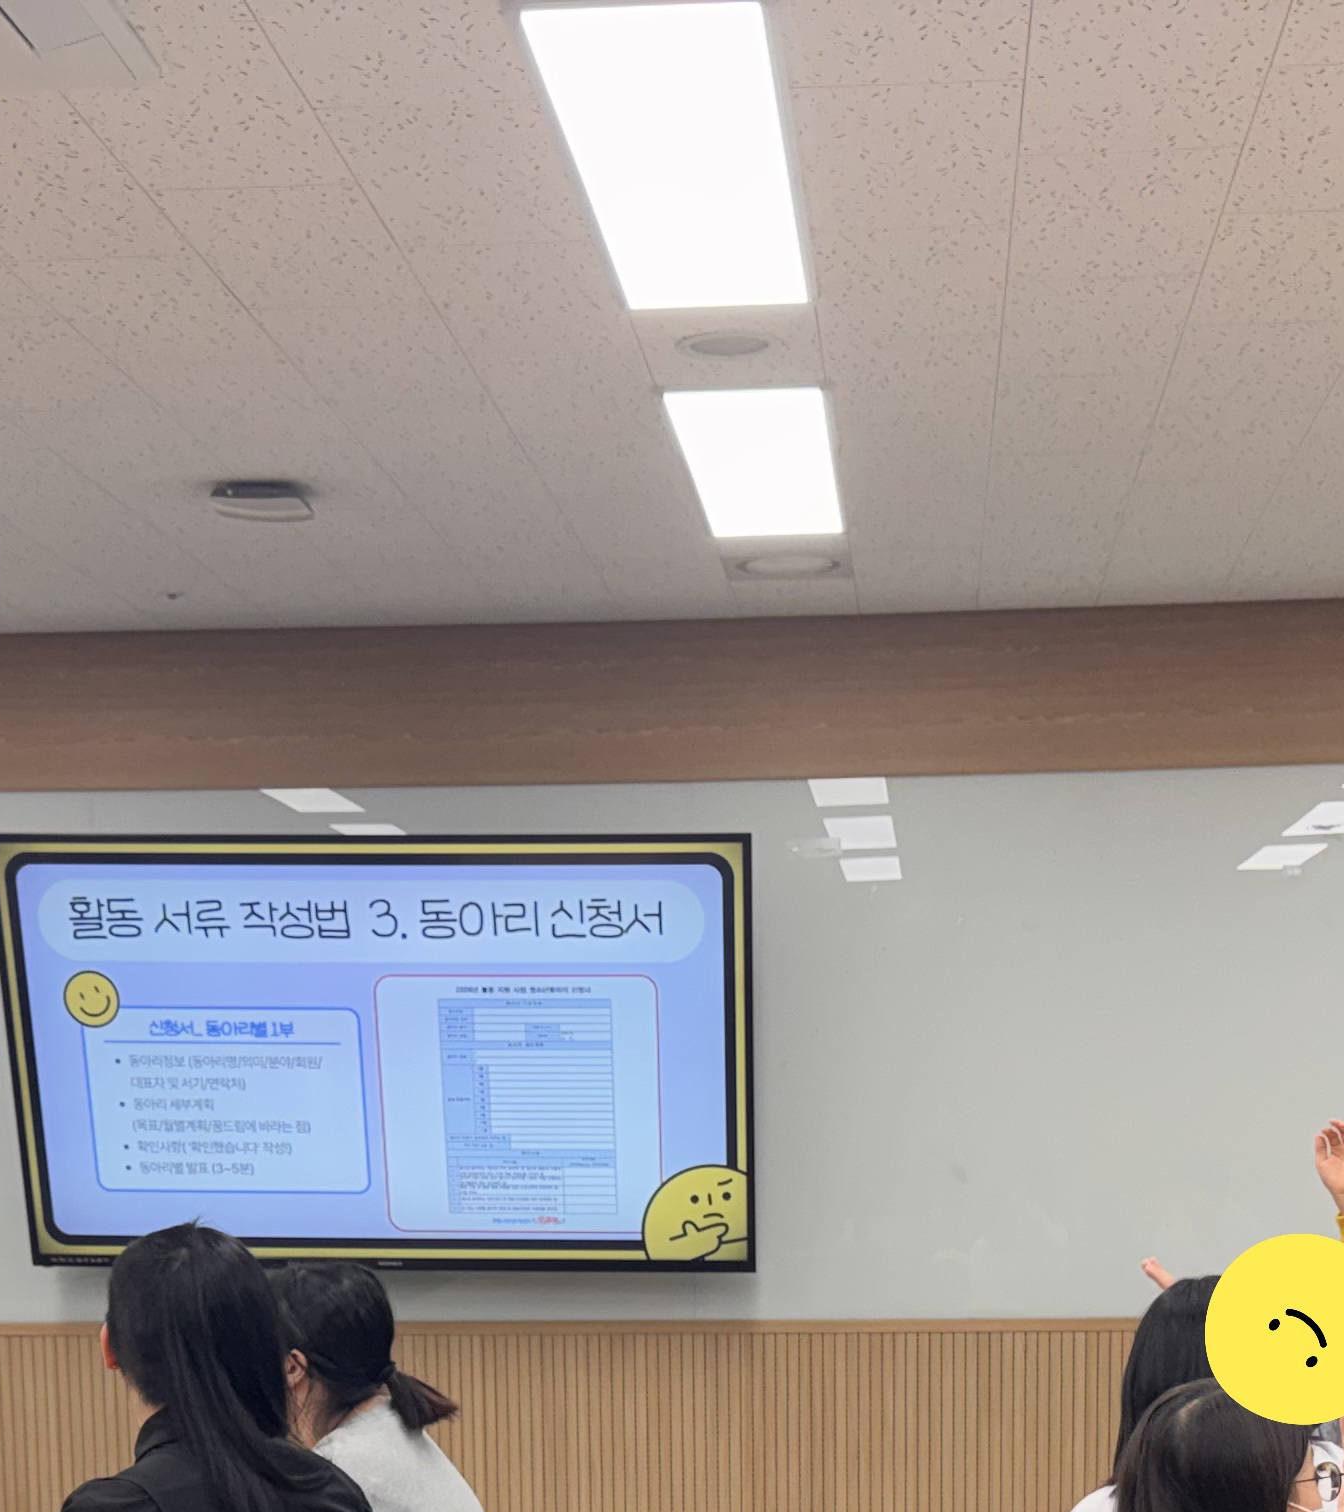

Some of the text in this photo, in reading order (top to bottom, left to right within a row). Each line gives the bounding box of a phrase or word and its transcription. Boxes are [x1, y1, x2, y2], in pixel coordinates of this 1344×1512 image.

[69, 896, 664, 940] 활동 서류 작성법 3. 동아리 신청서
[206, 1020, 268, 1038] 동아리별
[270, 1021, 295, 1038] 1부
[129, 1054, 186, 1068] 동아리정보
[130, 1077, 165, 1090] 대표자
[169, 1077, 180, 1090] 및
[133, 1098, 214, 1111] 동아리 세부계획
[259, 1120, 293, 1133] 바라는
[139, 1161, 256, 1176] 동아리별 발표 (3~5분)
